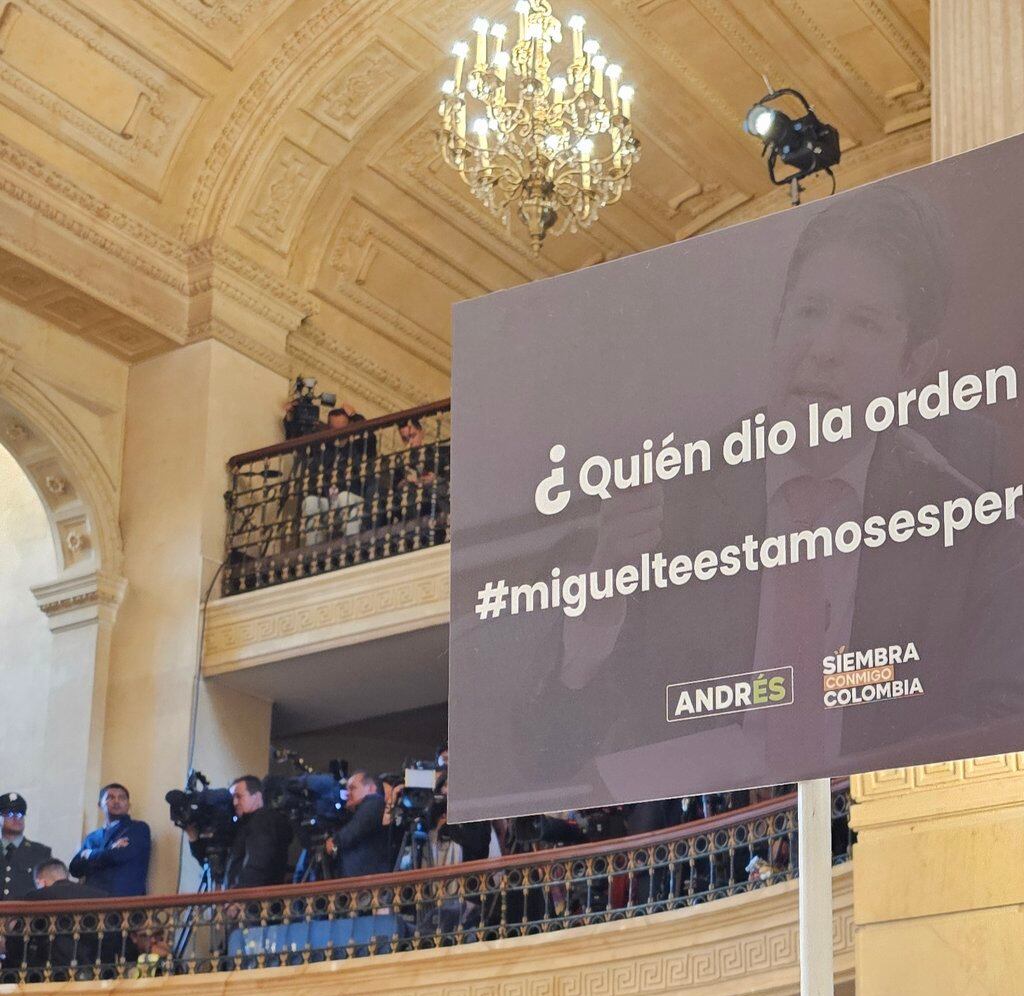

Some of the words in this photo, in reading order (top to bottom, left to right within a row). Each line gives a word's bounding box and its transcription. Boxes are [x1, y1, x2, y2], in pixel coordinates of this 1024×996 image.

[534, 431, 711, 515] ¿Quién
[722, 412, 797, 466] dio
[808, 402, 852, 448] la
[822, 642, 920, 675] SIEMBRA
[674, 673, 787, 716] ANDRÉS
[823, 677, 924, 707] COLOMBIA
[825, 667, 892, 689] CONMIGO
